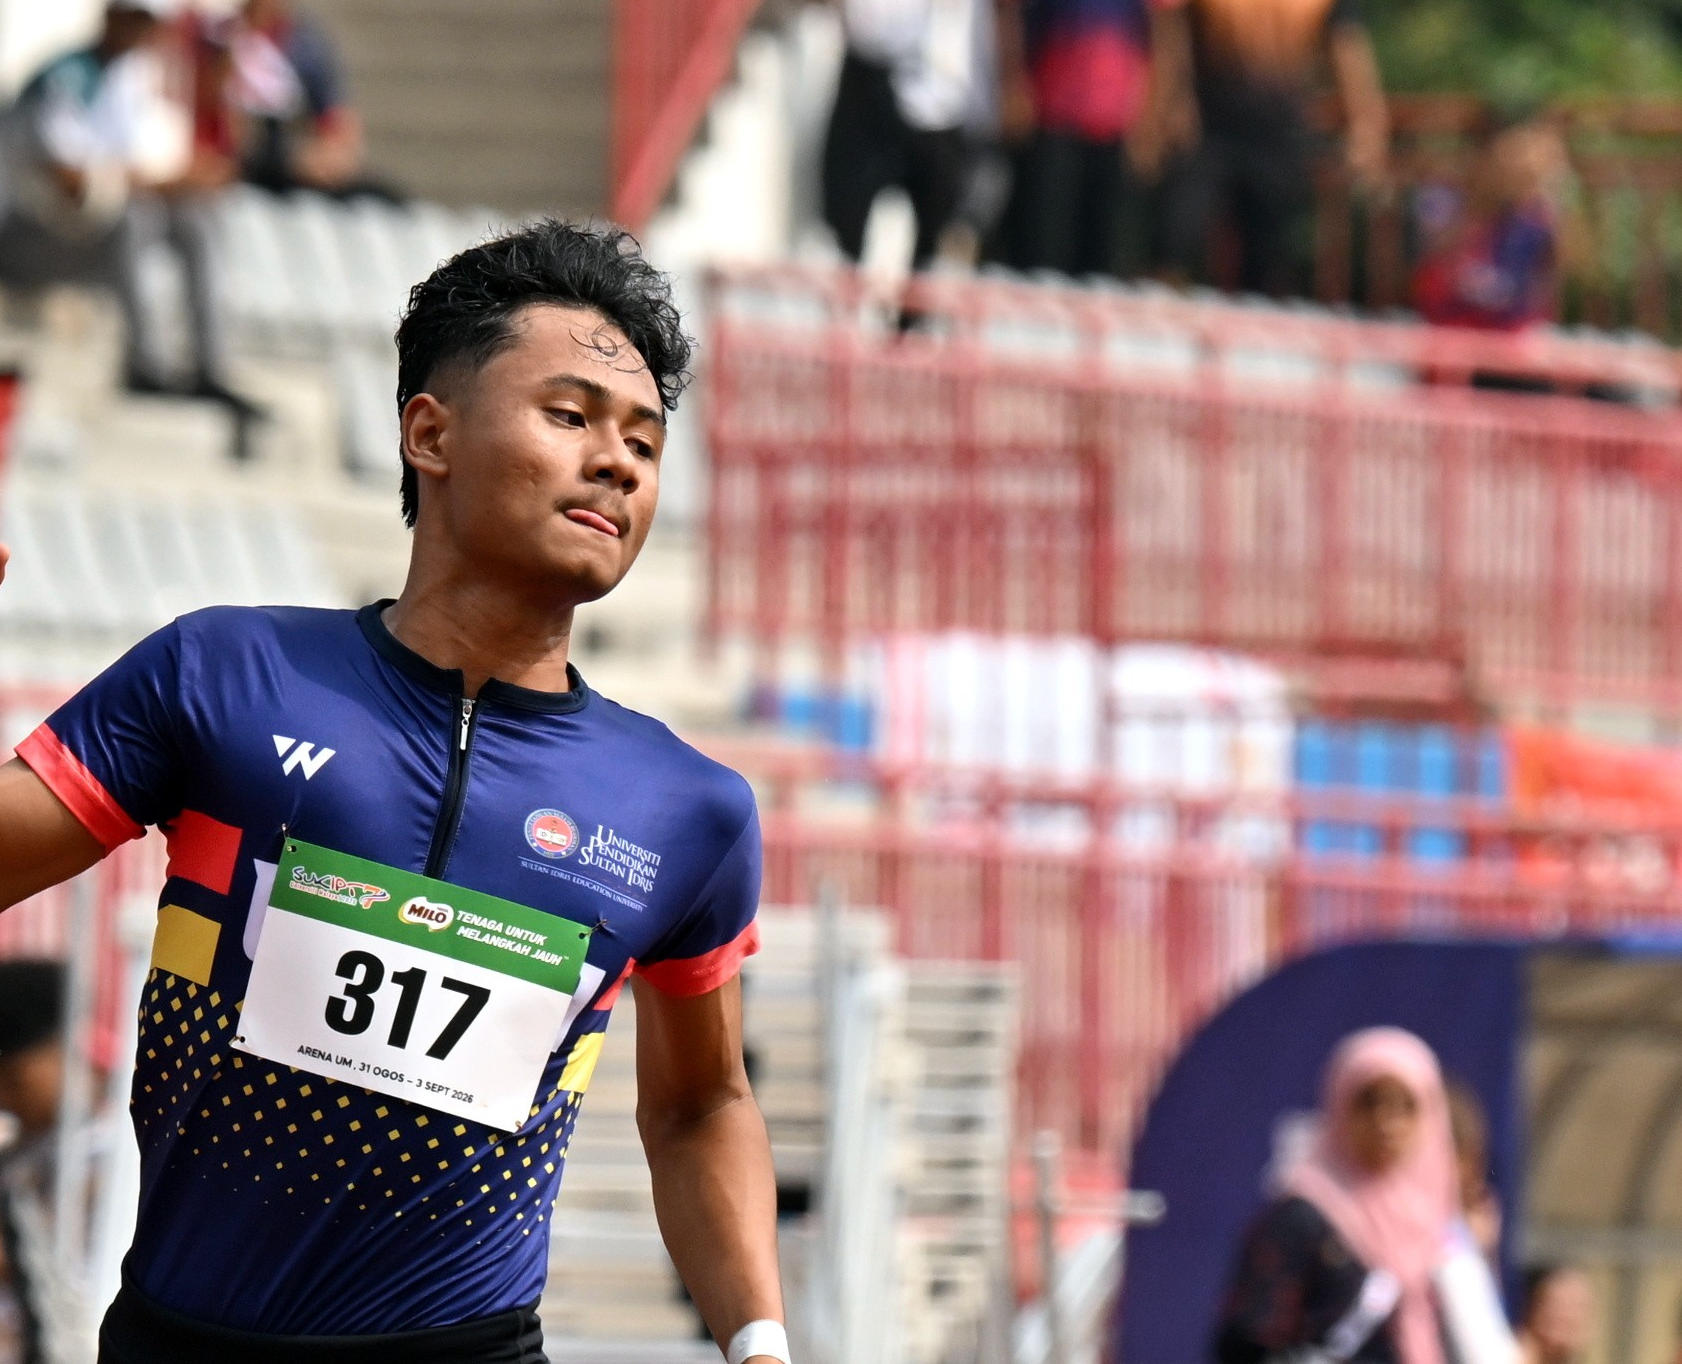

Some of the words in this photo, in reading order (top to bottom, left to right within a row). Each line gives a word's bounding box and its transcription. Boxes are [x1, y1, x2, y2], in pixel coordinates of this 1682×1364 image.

[589, 835, 658, 879] PENDIDIKAN
[598, 824, 661, 867] UNIVERSITI
[521, 860, 549, 874] SULTAN
[550, 869, 571, 881] IDRIS
[572, 876, 612, 899] EDUCATION
[578, 847, 626, 878] SULTAN
[627, 869, 655, 893] IDRIS
[408, 903, 447, 924] MILO
[456, 910, 504, 933] TENAGA
[505, 925, 548, 946] UNTUK
[457, 926, 531, 956] MELANGKAH
[324, 950, 491, 1060] 317
[297, 1044, 333, 1063] ARENA
[359, 1062, 371, 1073] 31
[373, 1067, 405, 1083] OGOS
[415, 1078, 423, 1088] 3
[424, 1081, 451, 1096] SEPT
[451, 1090, 474, 1103] 2026
